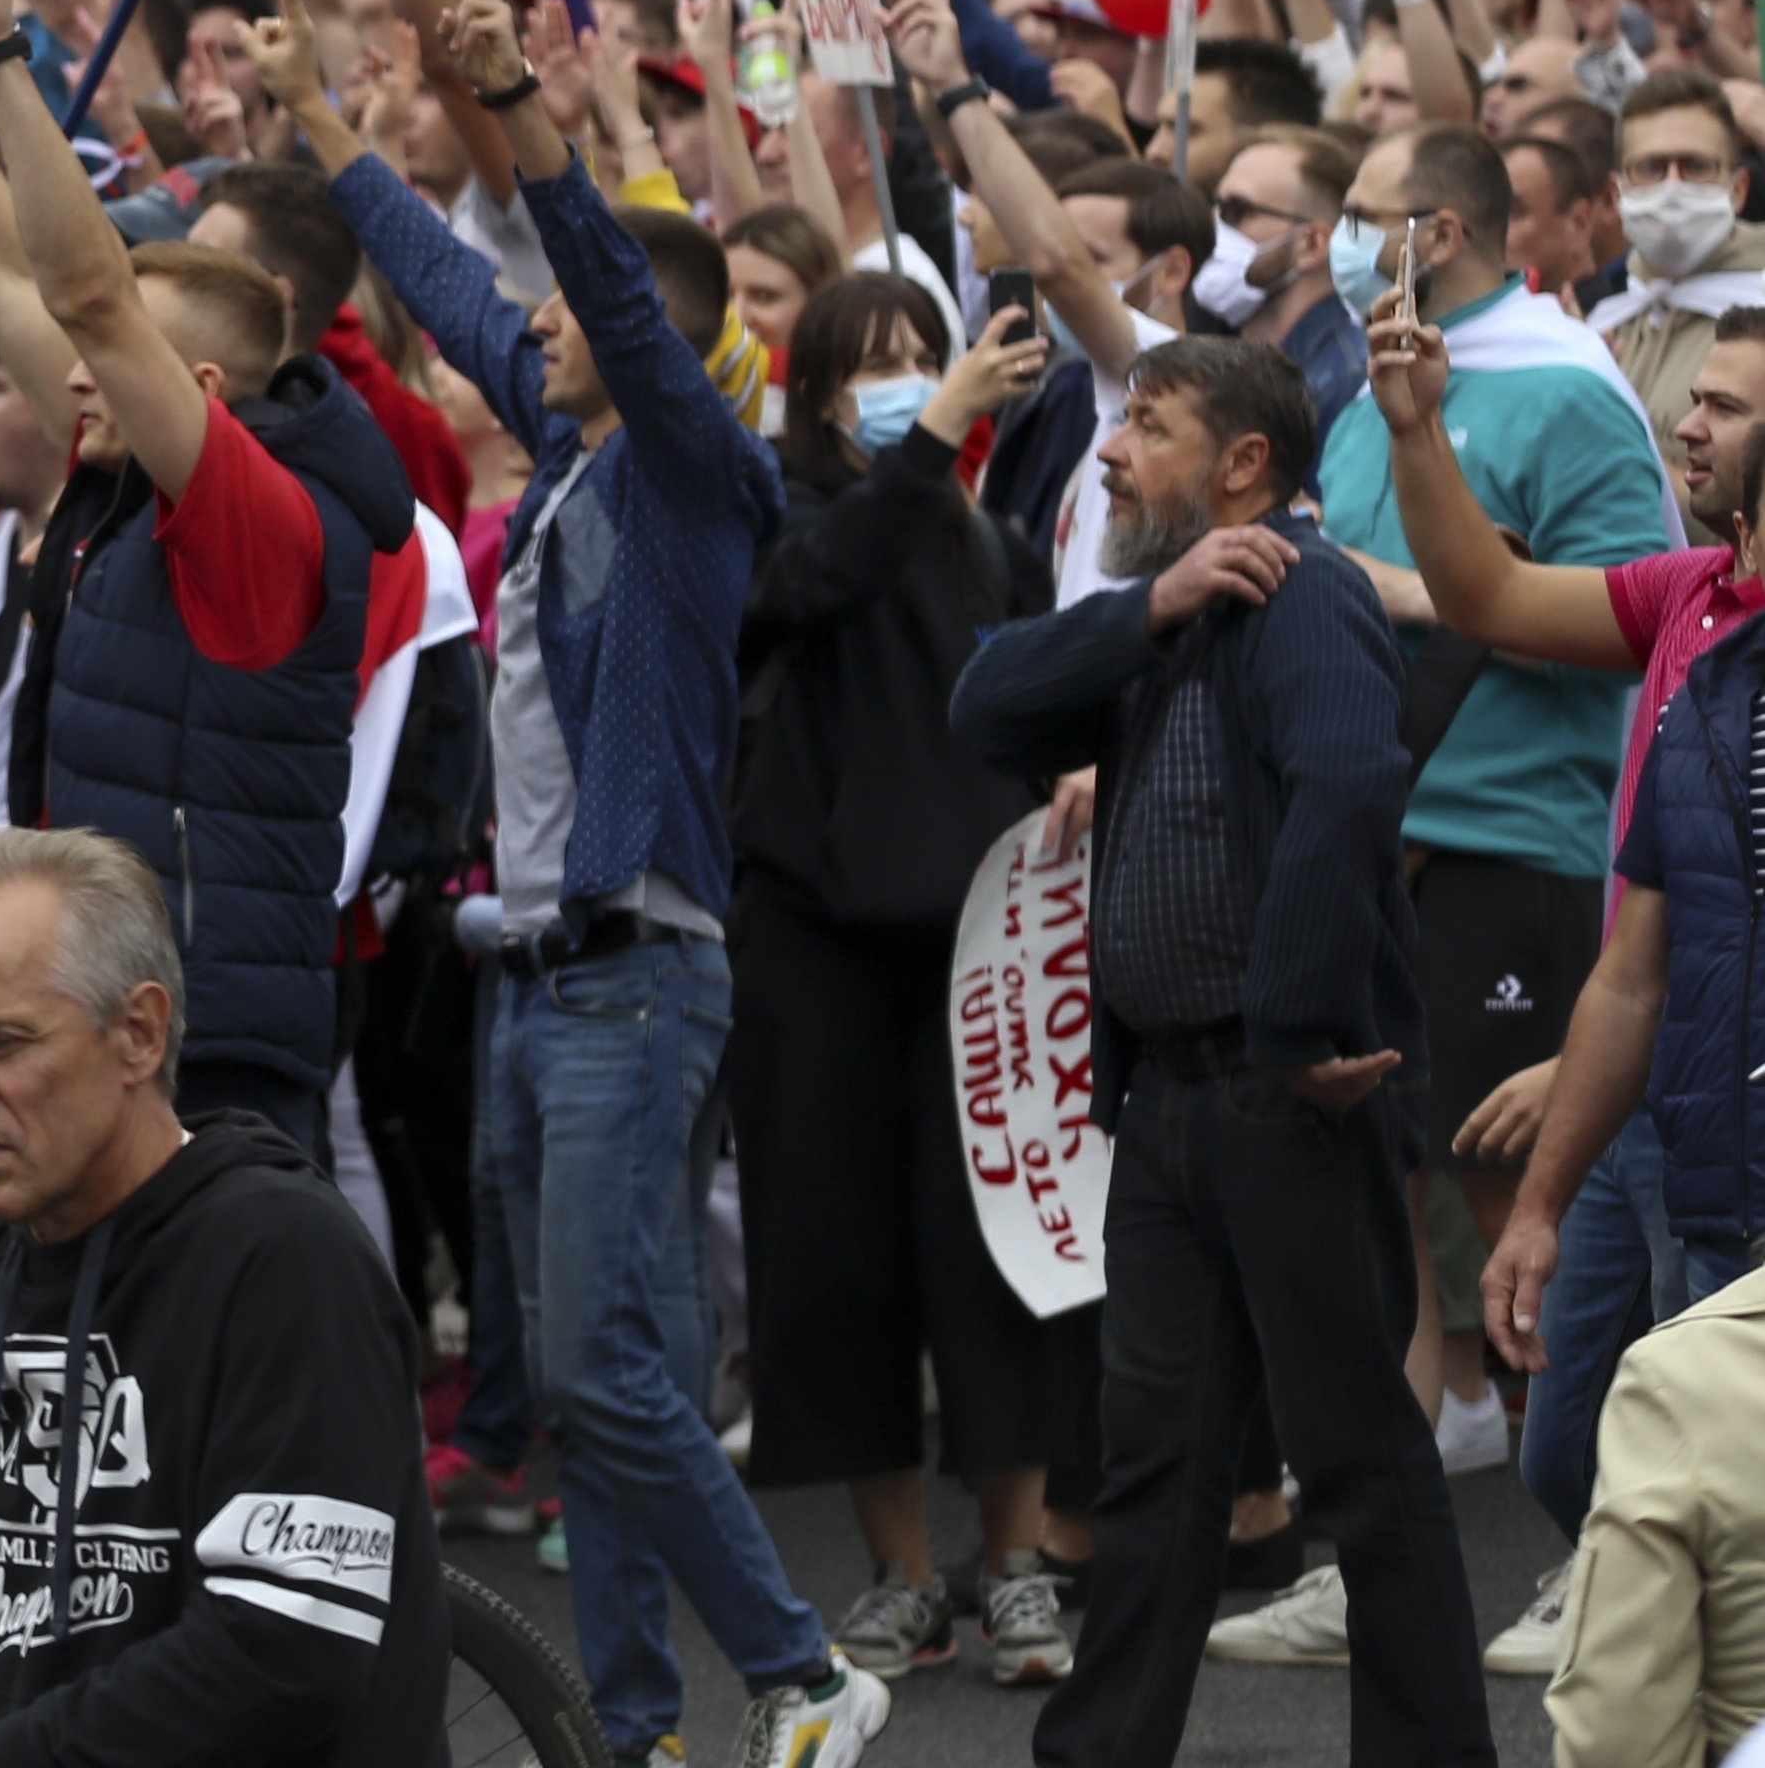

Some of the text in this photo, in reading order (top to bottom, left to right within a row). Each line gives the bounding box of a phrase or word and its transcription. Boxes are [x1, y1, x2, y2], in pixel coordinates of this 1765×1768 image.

[957, 963, 1018, 1186] САША!
[1021, 1139, 1087, 1263] ЛЕТО
[241, 1500, 394, 1577] Champion
